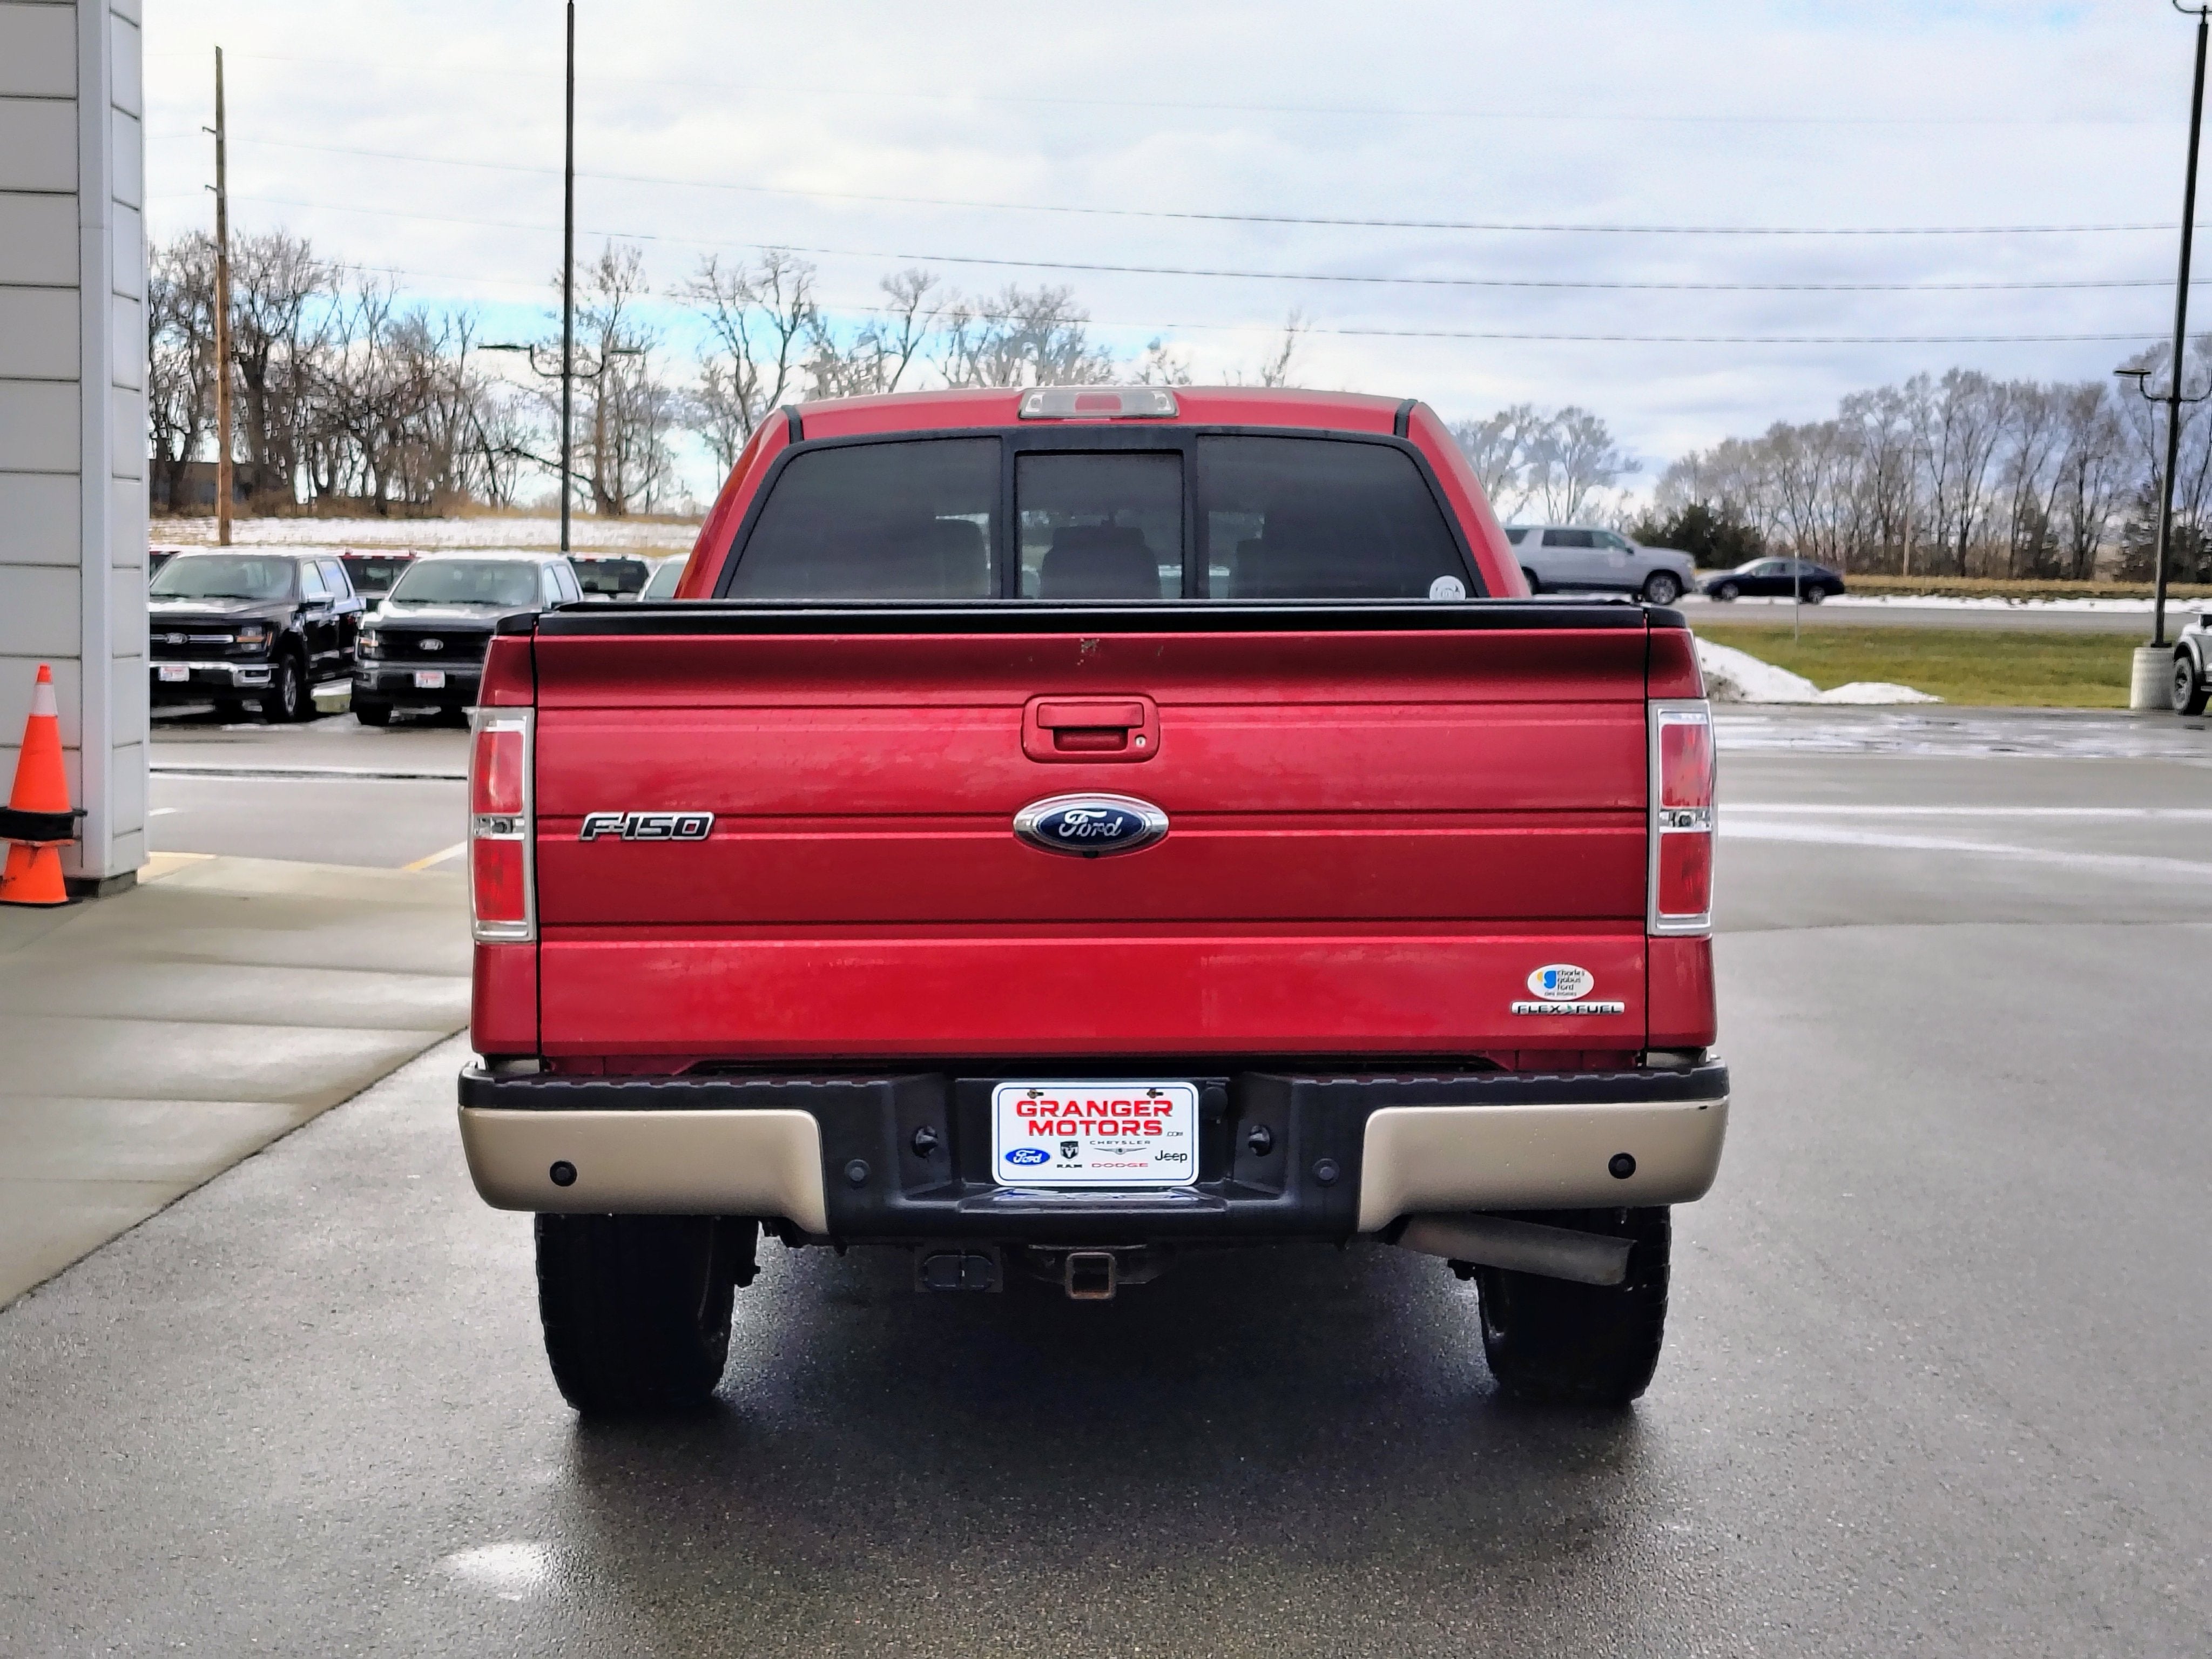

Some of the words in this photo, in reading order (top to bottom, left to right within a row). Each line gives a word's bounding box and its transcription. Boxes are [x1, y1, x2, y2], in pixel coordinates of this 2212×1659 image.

[579, 811, 715, 840] F-150
[1058, 810, 1124, 837] Ford
[1517, 1004, 1561, 1014] FLEX
[1576, 1004, 1622, 1014] FUEL
[1016, 1100, 1173, 1117] GRANGER
[1028, 1120, 1163, 1136] MOTORS
[1013, 1150, 1043, 1163] Ford
[1155, 1150, 1188, 1163] Jeep
